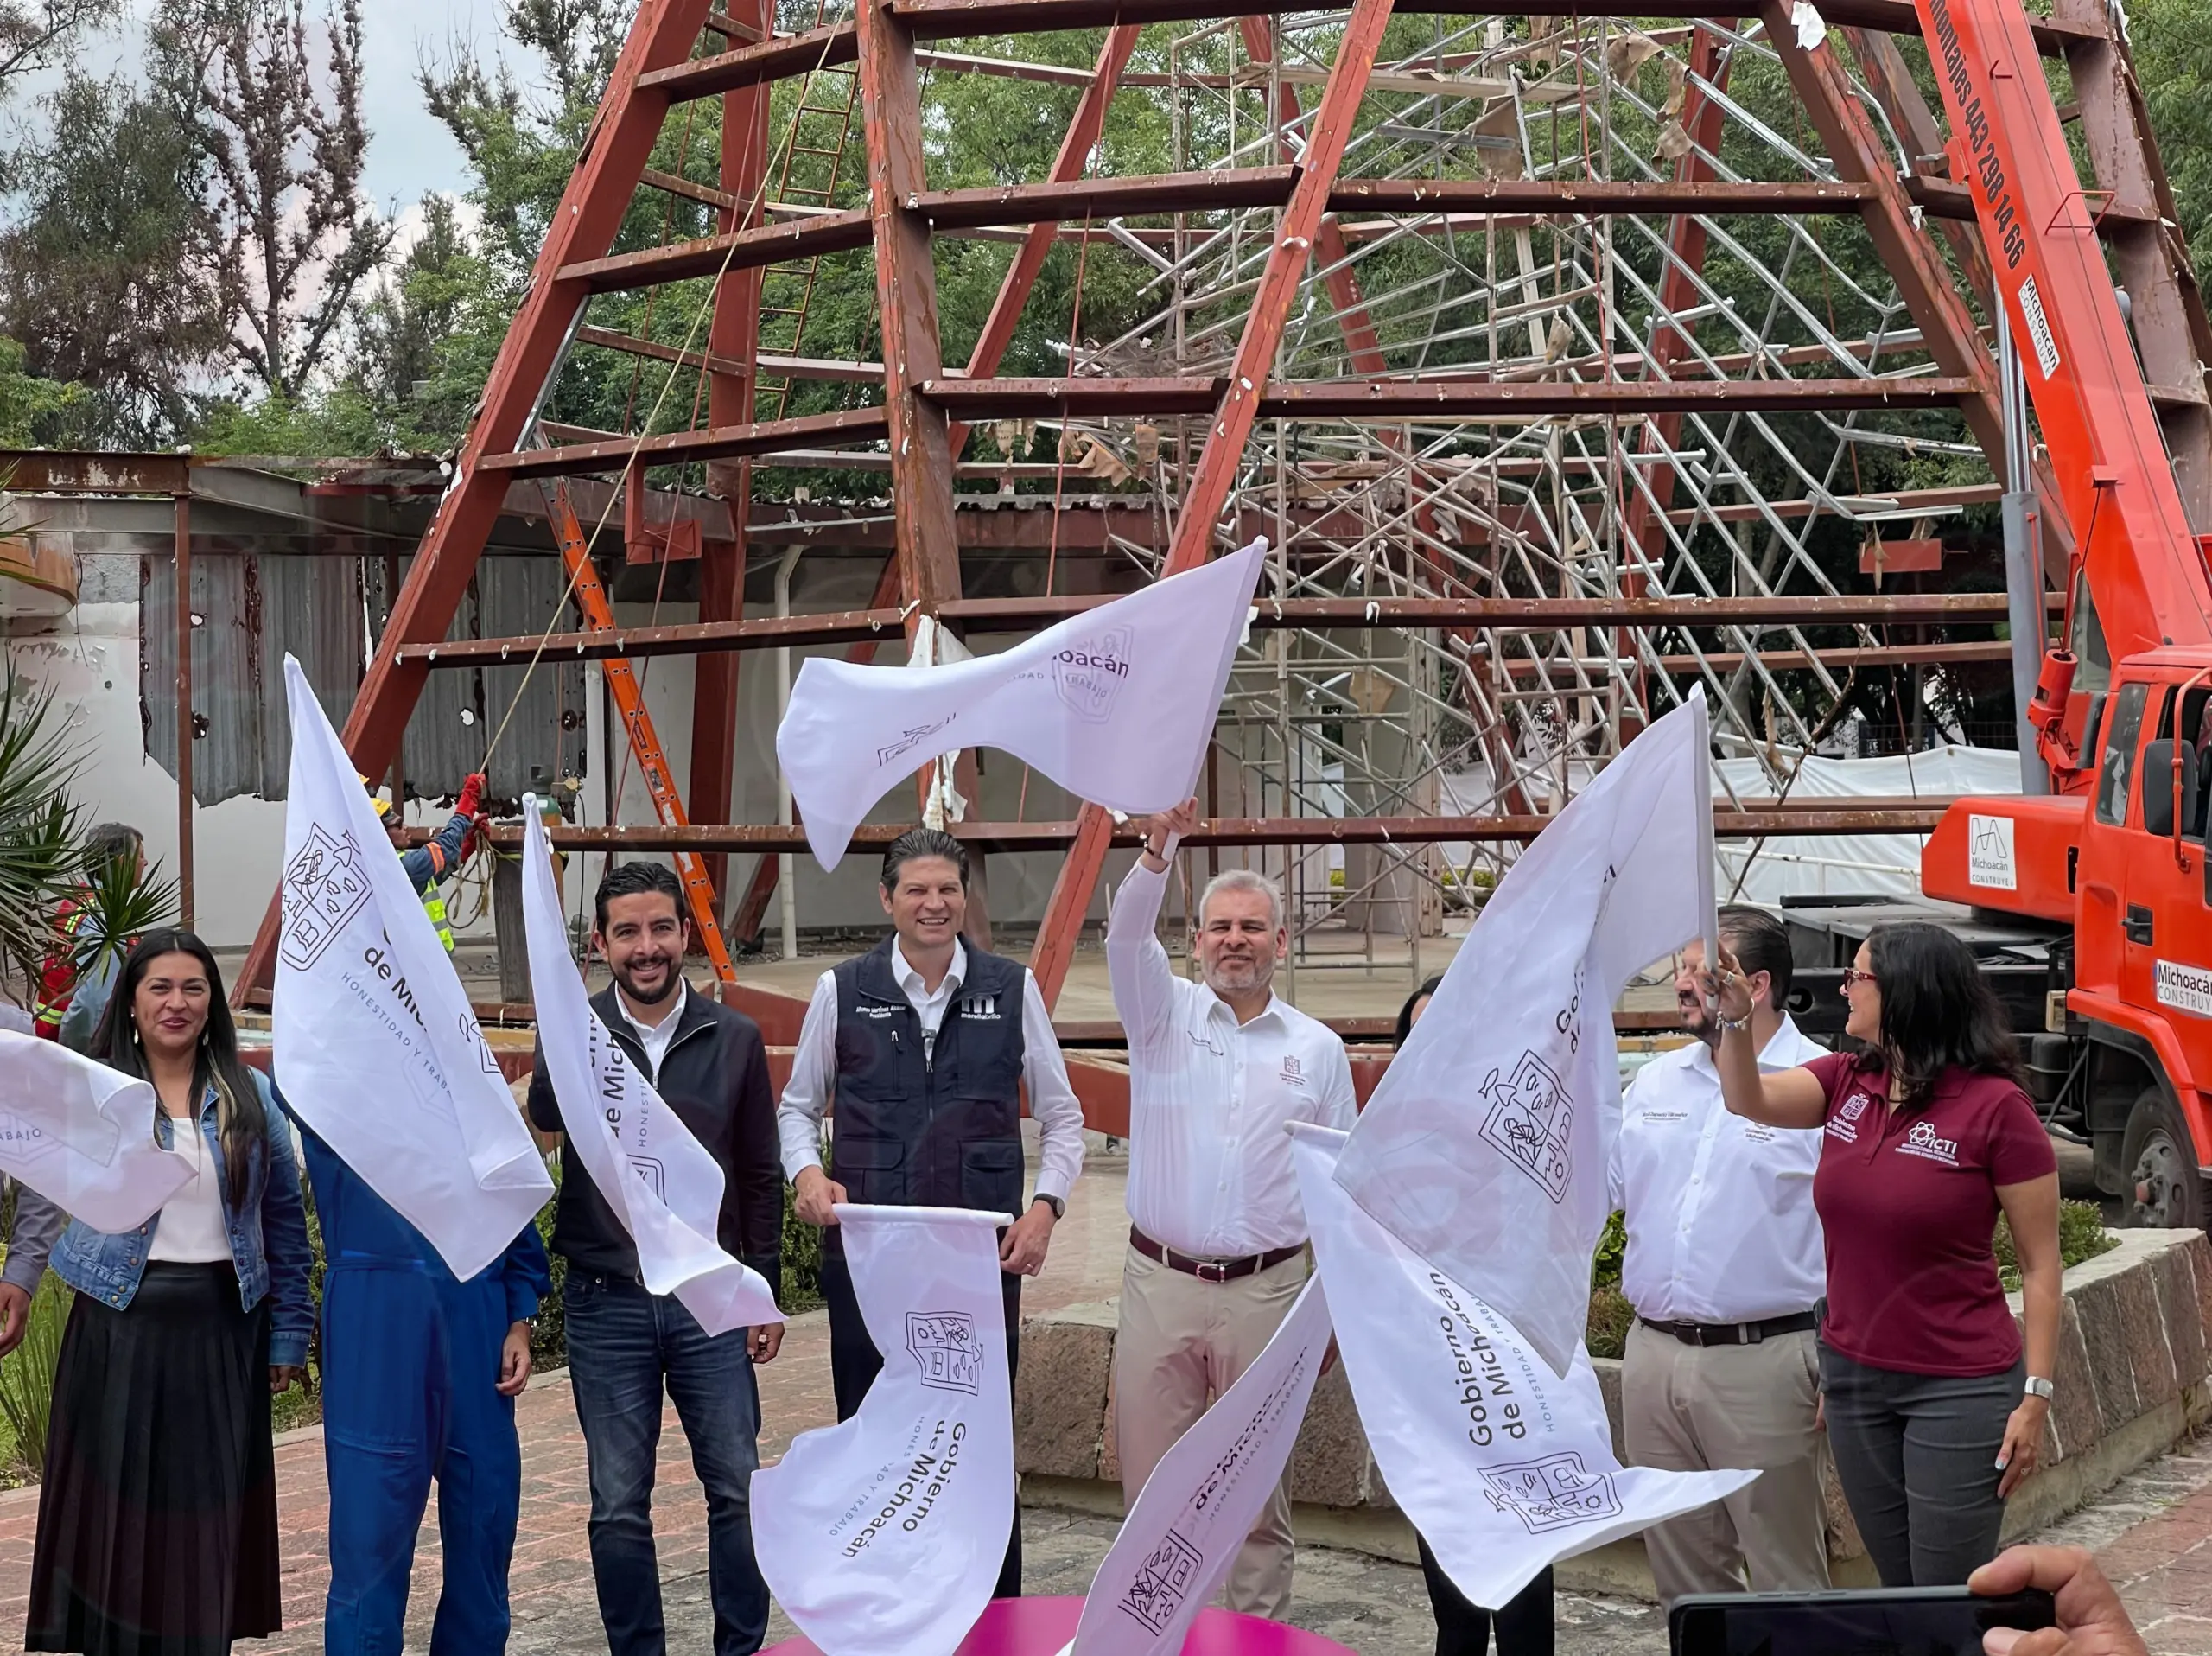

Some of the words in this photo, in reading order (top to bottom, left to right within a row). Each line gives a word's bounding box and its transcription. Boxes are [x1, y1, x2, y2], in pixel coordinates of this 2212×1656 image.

[1965, 97, 1989, 154] 443
[1978, 143, 2005, 203] 298
[1994, 194, 2014, 235] 14
[2004, 223, 2025, 270] 66
[2020, 288, 2051, 376] CONSTRUYE
[2026, 277, 2056, 368] Michoacán
[1052, 649, 1129, 679] oacán
[1972, 857, 2008, 871] Michoacán
[364, 947, 391, 981] de
[2158, 964, 2212, 996] Michoacá
[341, 971, 410, 1047] HONESTIDAD
[414, 1048, 421, 1057] Y
[1430, 1272, 1514, 1397] Michoacán
[1440, 1316, 1492, 1447] Gobierno
[1502, 1403, 1527, 1440] de
[1512, 1347, 1555, 1432] HONESTIDAD
[829, 1494, 868, 1536] TRABAJO
[842, 1454, 936, 1557] Michoacán
[902, 1422, 966, 1532] Gobierno
